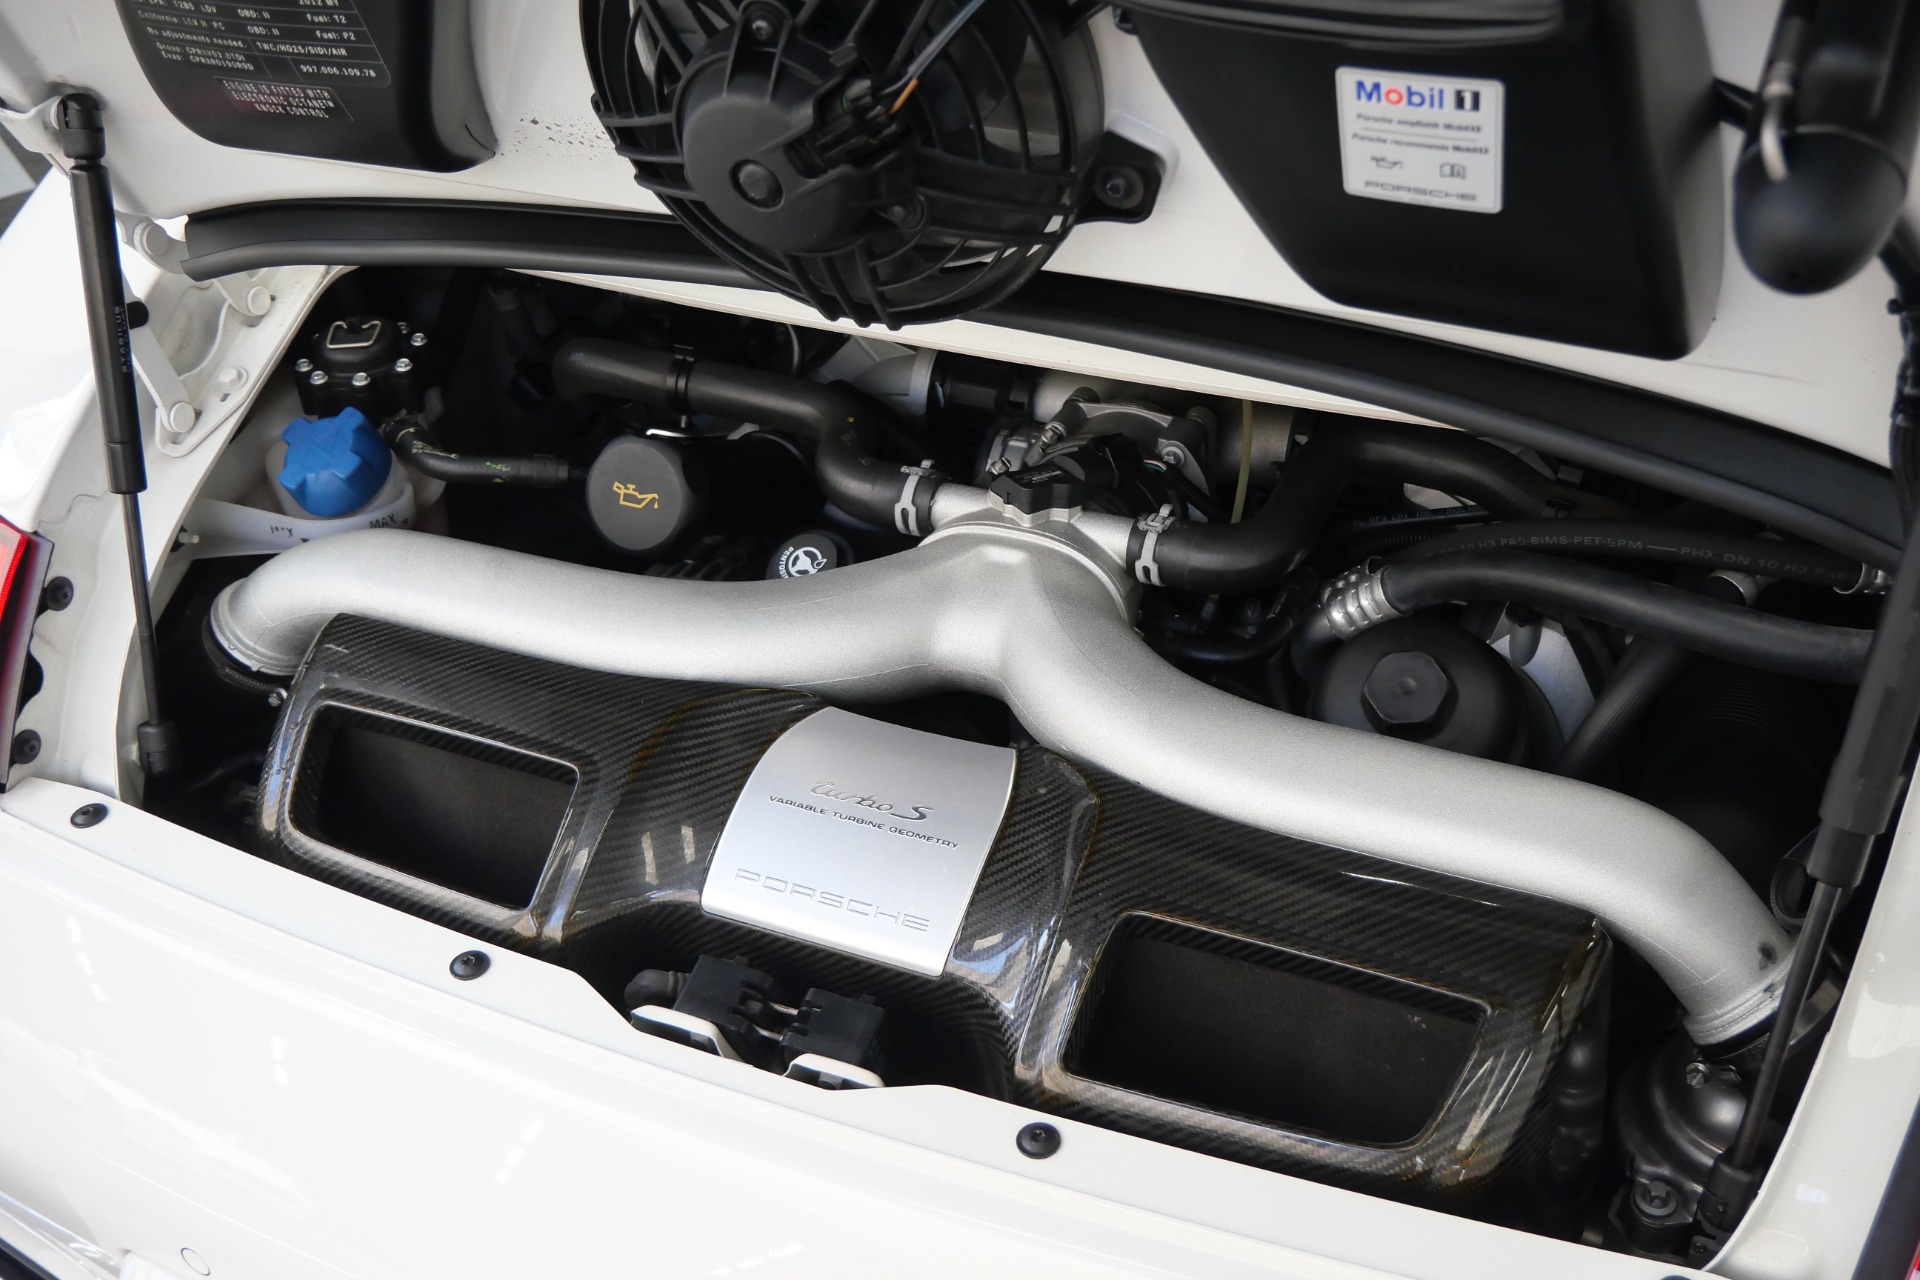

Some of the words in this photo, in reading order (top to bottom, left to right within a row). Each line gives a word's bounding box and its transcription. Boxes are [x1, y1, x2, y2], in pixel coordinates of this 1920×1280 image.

[138, 10, 181, 23] California:
[238, 8, 261, 19] OBD:
[306, 13, 331, 23] Fuel:
[333, 14, 347, 24] T2
[147, 26, 159, 36] No
[161, 29, 211, 43] adjustments
[213, 38, 248, 48] needed.
[247, 25, 271, 36] OBD:
[315, 30, 340, 40] Fuel:
[342, 32, 356, 41] P2
[300, 64, 377, 78] 997.006.109.78
[222, 80, 258, 93] ENGINE
[258, 84, 270, 94] IS
[271, 85, 304, 97] FITTED
[306, 88, 331, 99] WITH
[1355, 79, 1445, 110] Mobil
[1455, 89, 1480, 112] 1
[231, 91, 288, 105] ELECTRONIC
[254, 103, 286, 114] KNOCK
[286, 106, 329, 119] CONTROL
[1356, 112, 1393, 124] Porsche
[1352, 132, 1388, 144] Porsche
[1365, 180, 1477, 202] PORSCHE
[115, 306, 127, 373] STABILUS
[1723, 552, 1750, 566] DN
[1757, 558, 1779, 570] 10
[1784, 562, 1809, 575] H3
[889, 804, 934, 822] S
[769, 795, 828, 816] VARIABLE
[832, 810, 886, 831] TURBINE
[889, 825, 960, 850] GEOMETRY
[735, 868, 931, 933] PORSCHE
